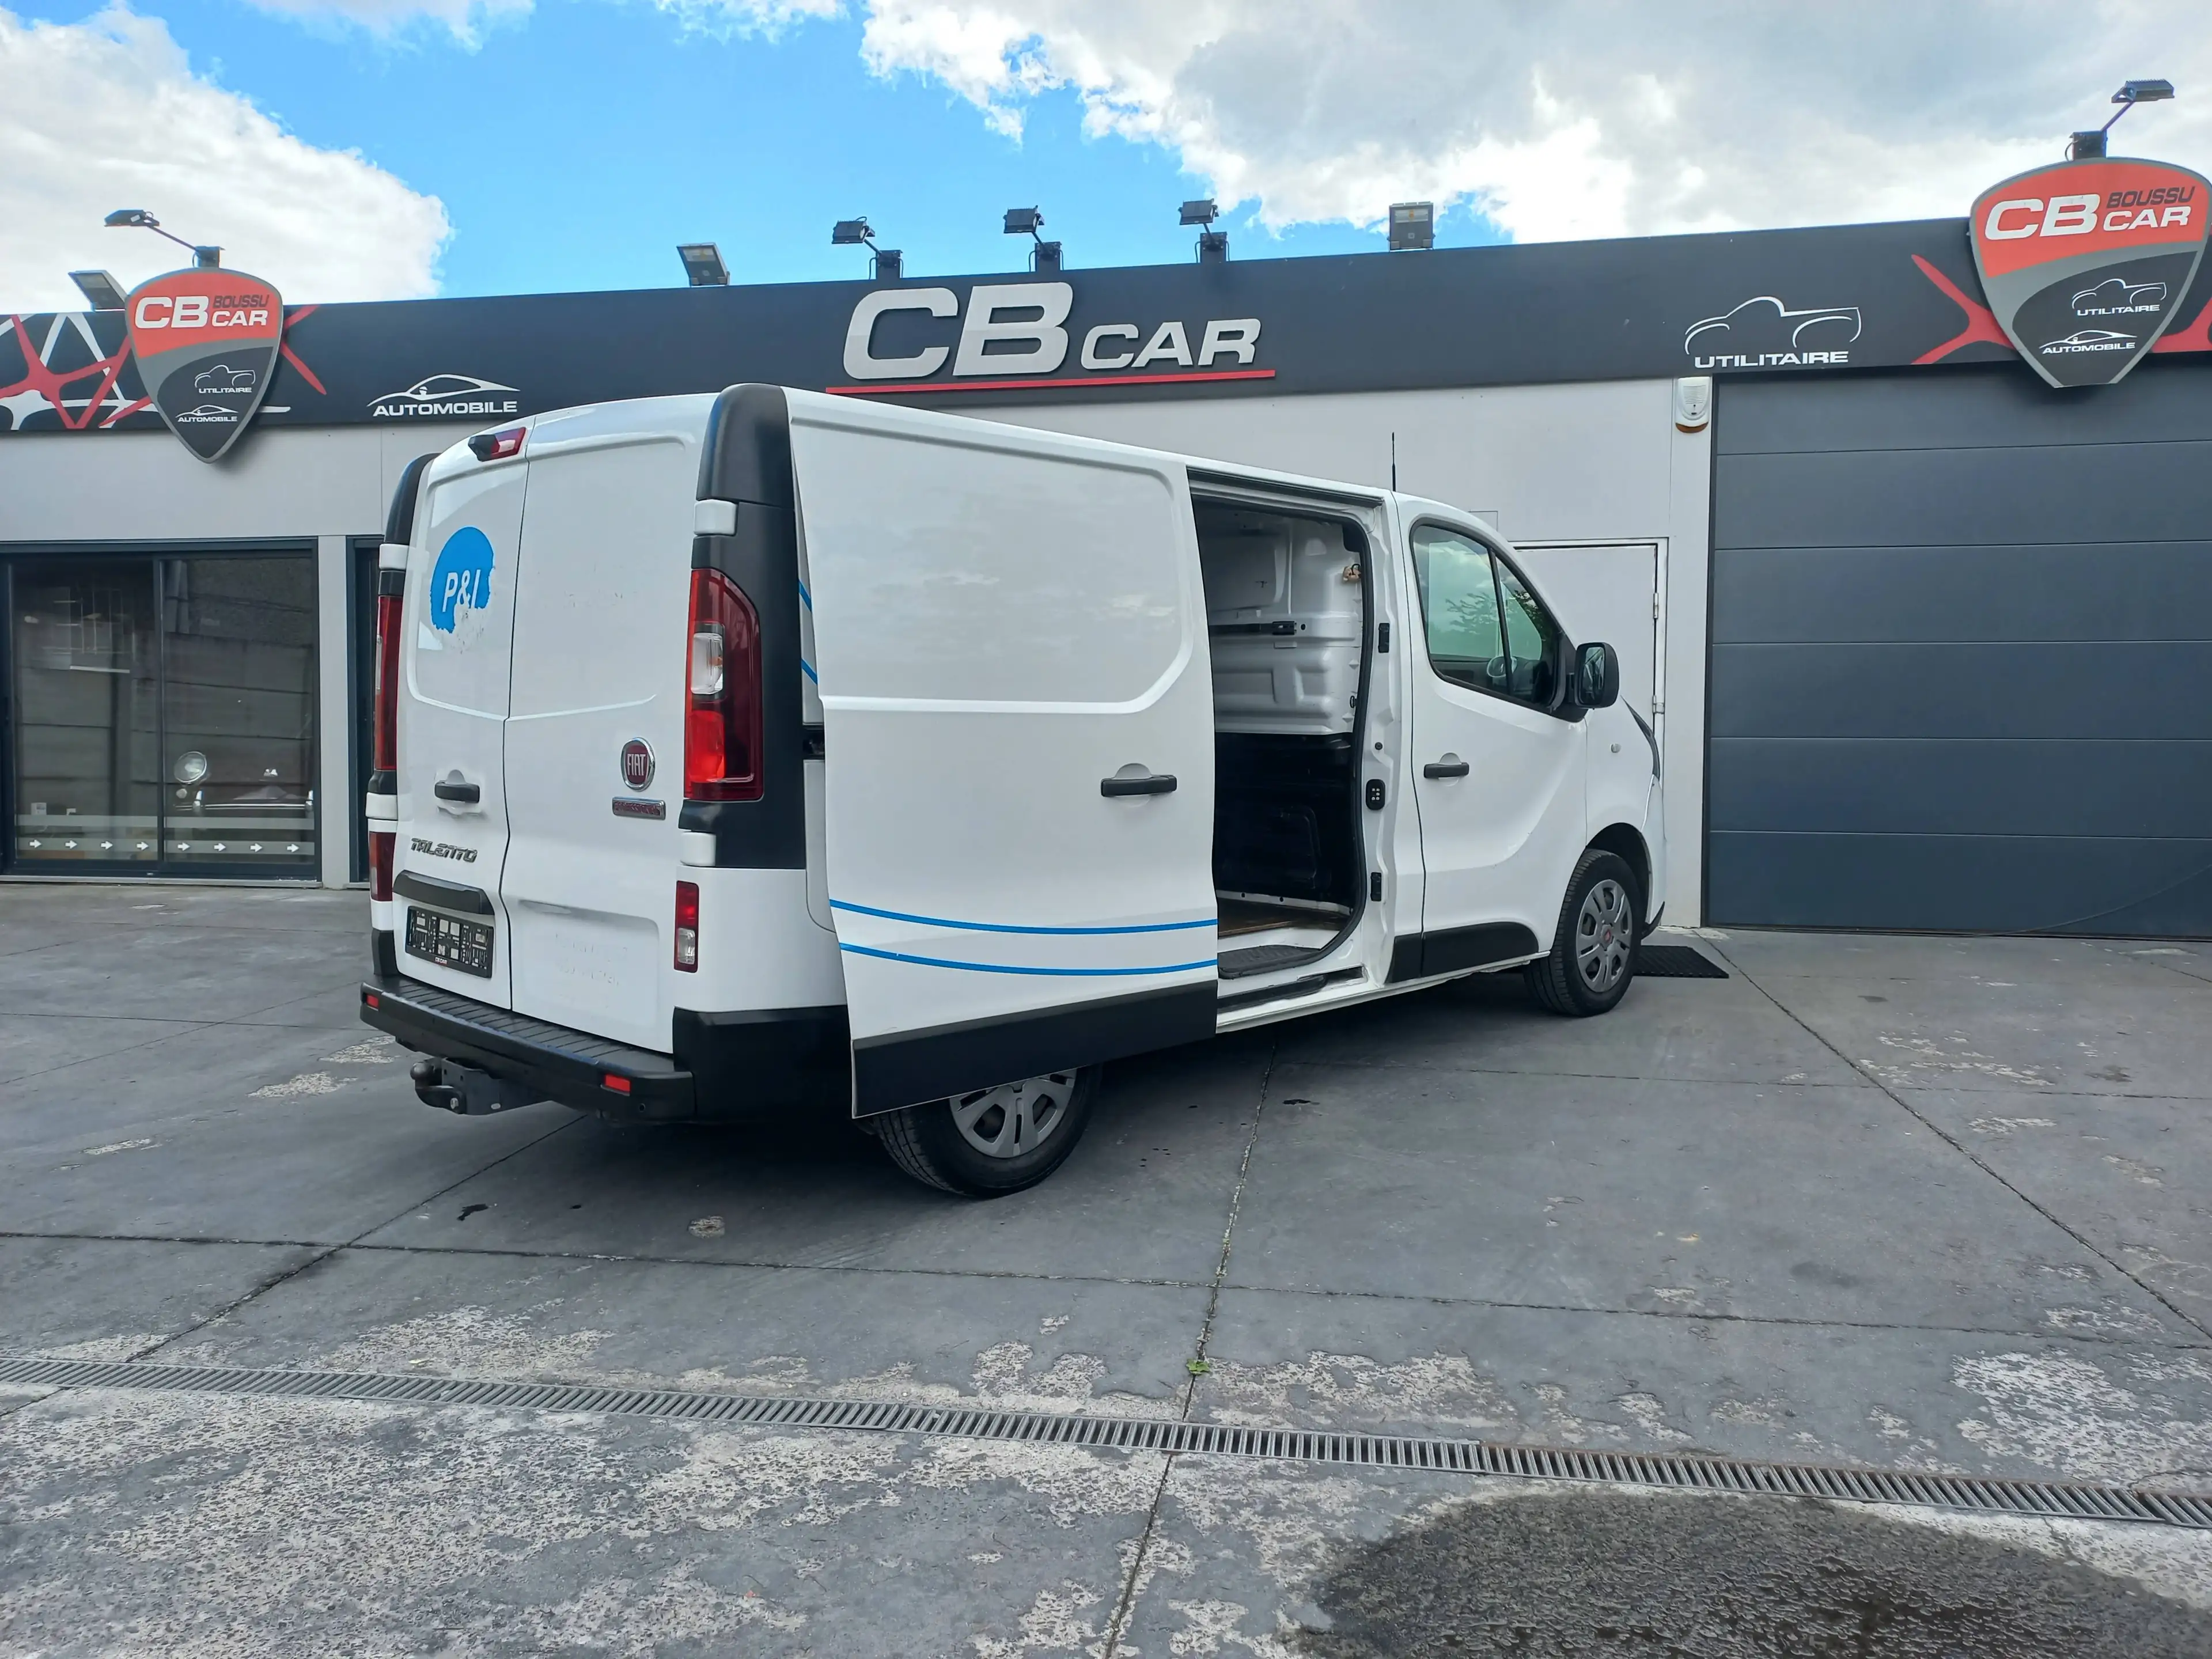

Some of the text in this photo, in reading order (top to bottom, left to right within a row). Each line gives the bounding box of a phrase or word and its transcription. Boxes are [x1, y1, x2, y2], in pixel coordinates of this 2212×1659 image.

[2106, 186, 2196, 208] BOUSSU
[1984, 194, 2192, 240] CB CAR
[213, 294, 270, 308] BOUSSU
[2077, 304, 2160, 316] UTILITAIRE
[135, 296, 268, 329] CB CAR
[843, 281, 1262, 380] CB CAR
[2042, 342, 2135, 354] AUTOMOBILE
[1694, 351, 1849, 369] UTILITAIRE
[373, 401, 517, 416] AUTOMOBILE
[627, 753, 646, 776] FIAT
[411, 838, 478, 863] TALENTO
